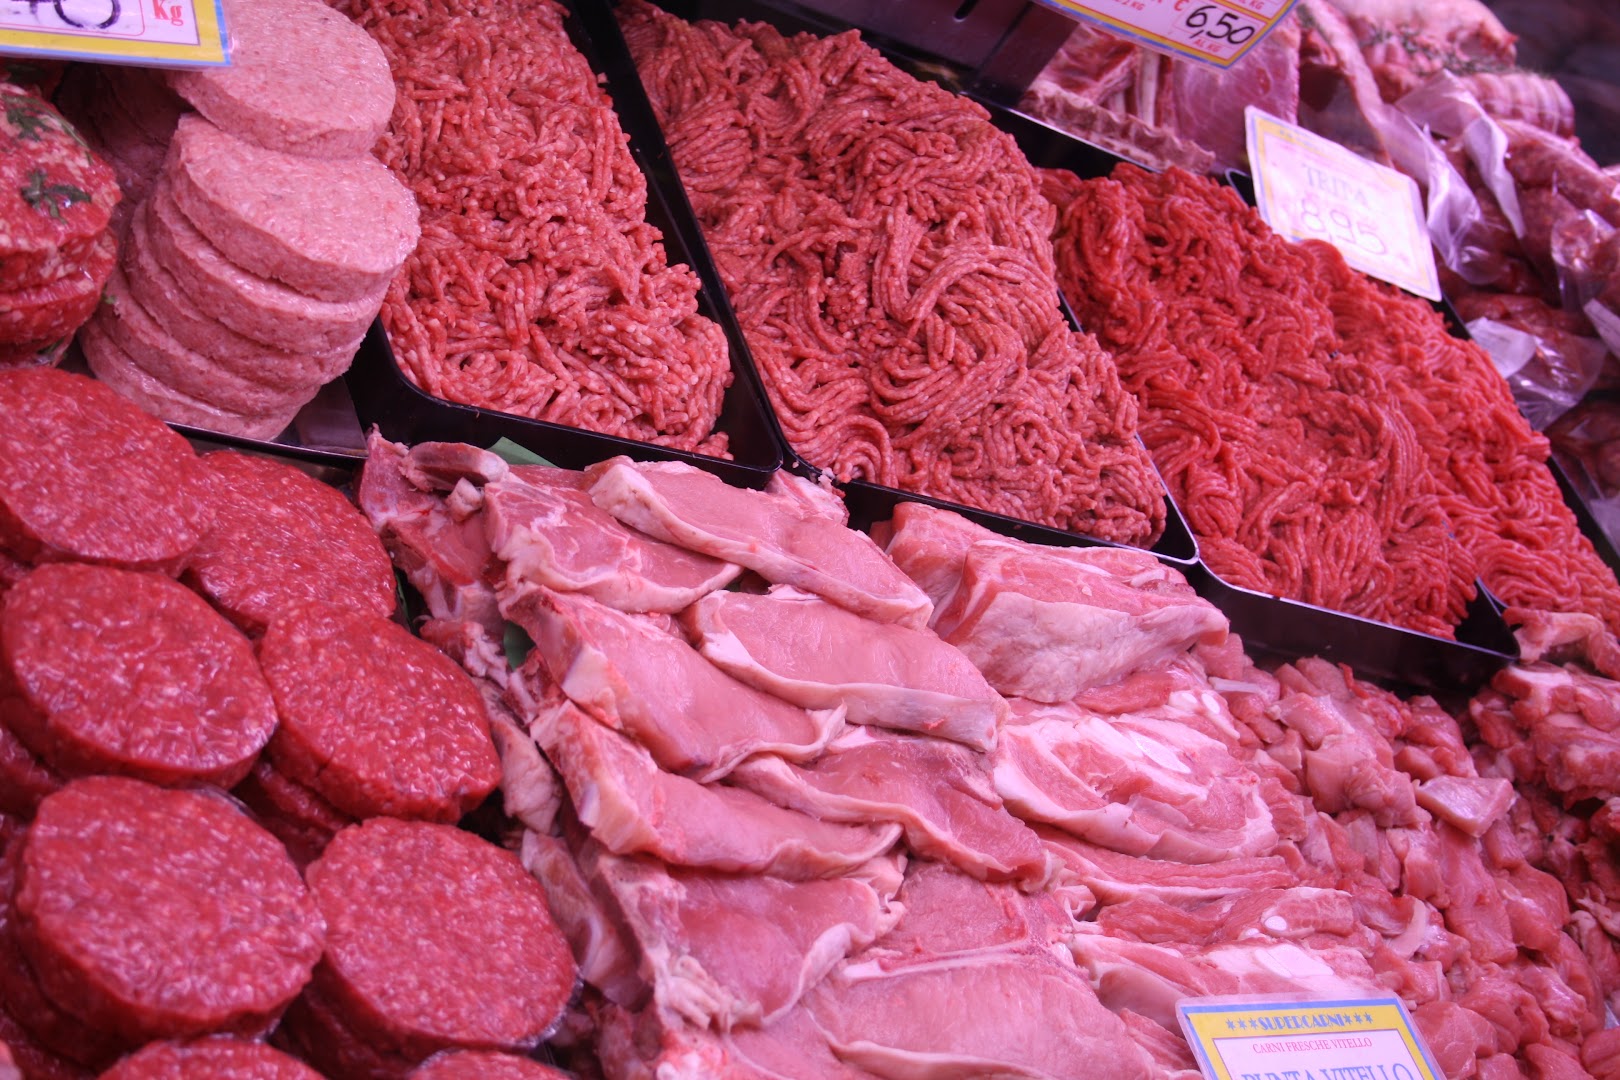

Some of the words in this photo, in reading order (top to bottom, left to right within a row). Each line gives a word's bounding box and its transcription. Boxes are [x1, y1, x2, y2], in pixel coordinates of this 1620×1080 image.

[152, 0, 184, 26] Kg
[1186, 5, 1256, 45] 6,50
[1252, 1041, 1286, 1054] CARNI
[1287, 1039, 1331, 1052] FRESCHE
[1330, 1037, 1373, 1049] VITELLO
